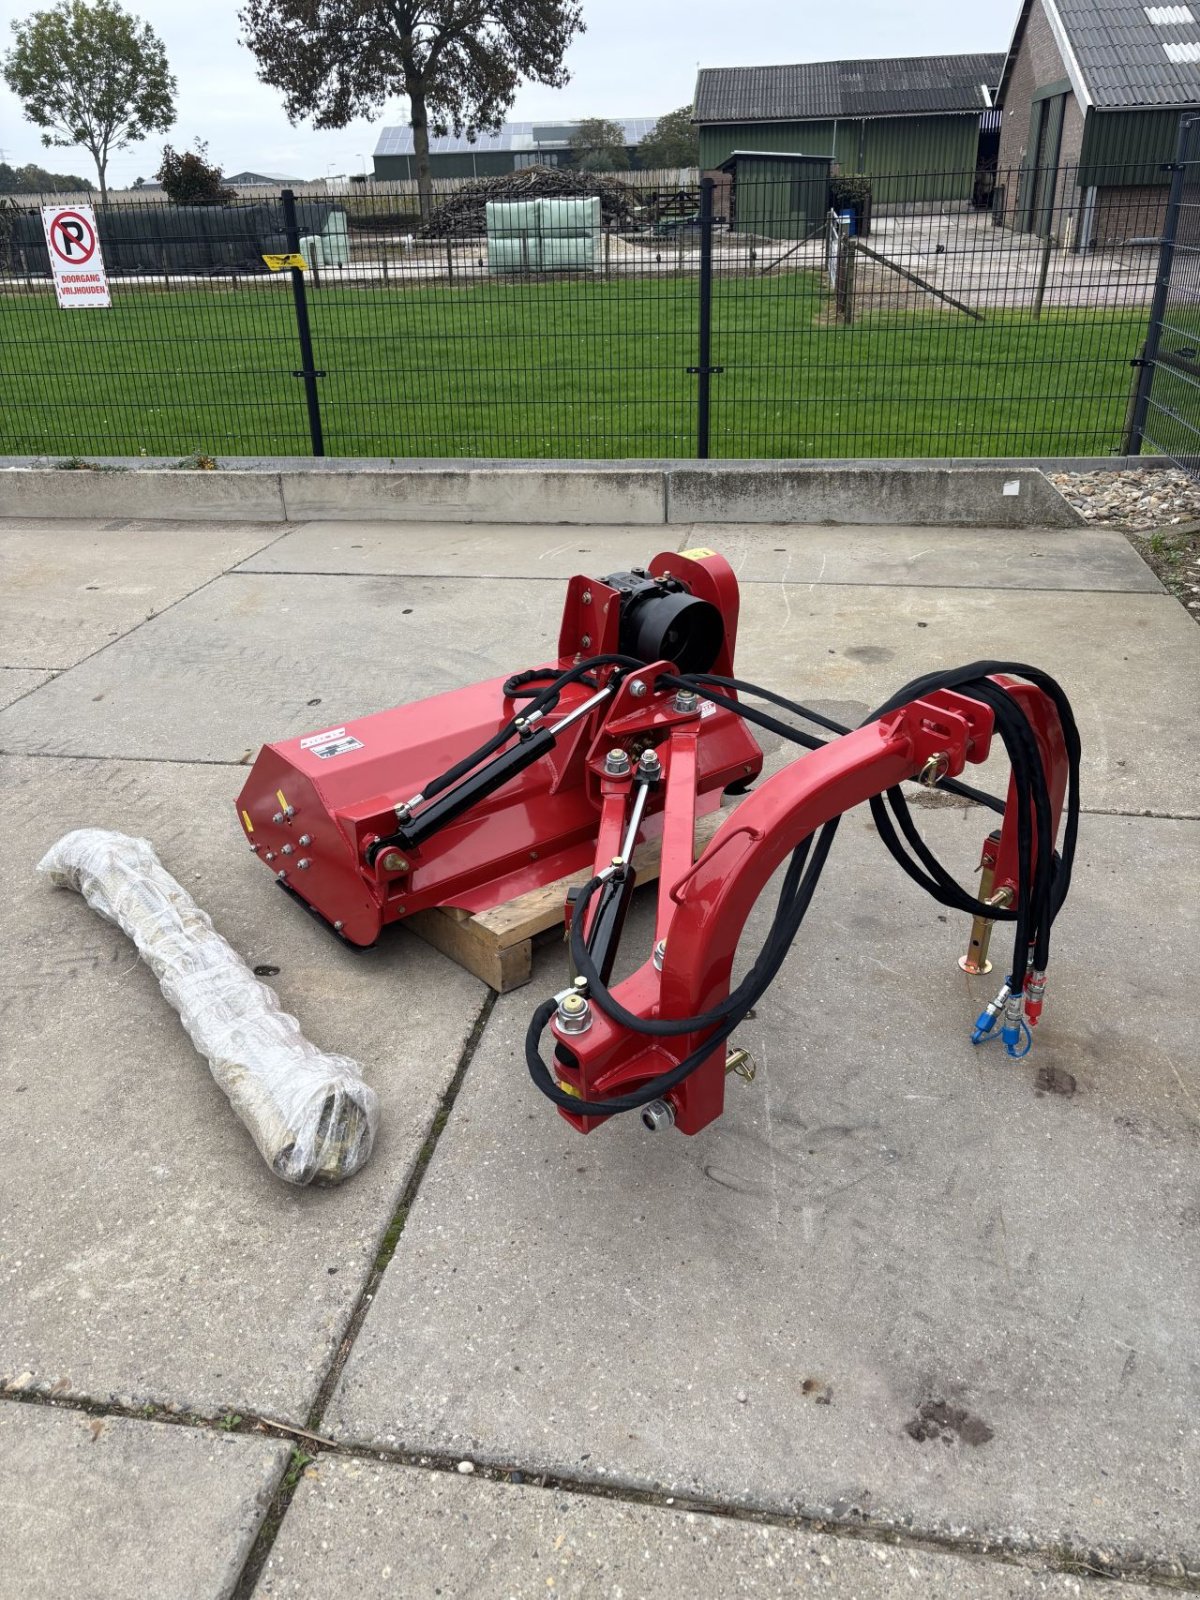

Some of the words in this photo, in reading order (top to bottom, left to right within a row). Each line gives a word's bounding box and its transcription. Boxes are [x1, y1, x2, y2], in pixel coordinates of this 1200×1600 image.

[60, 221, 84, 255] P
[61, 274, 100, 283] DOORGANG
[61, 286, 105, 295] VRIJHOUDEN
